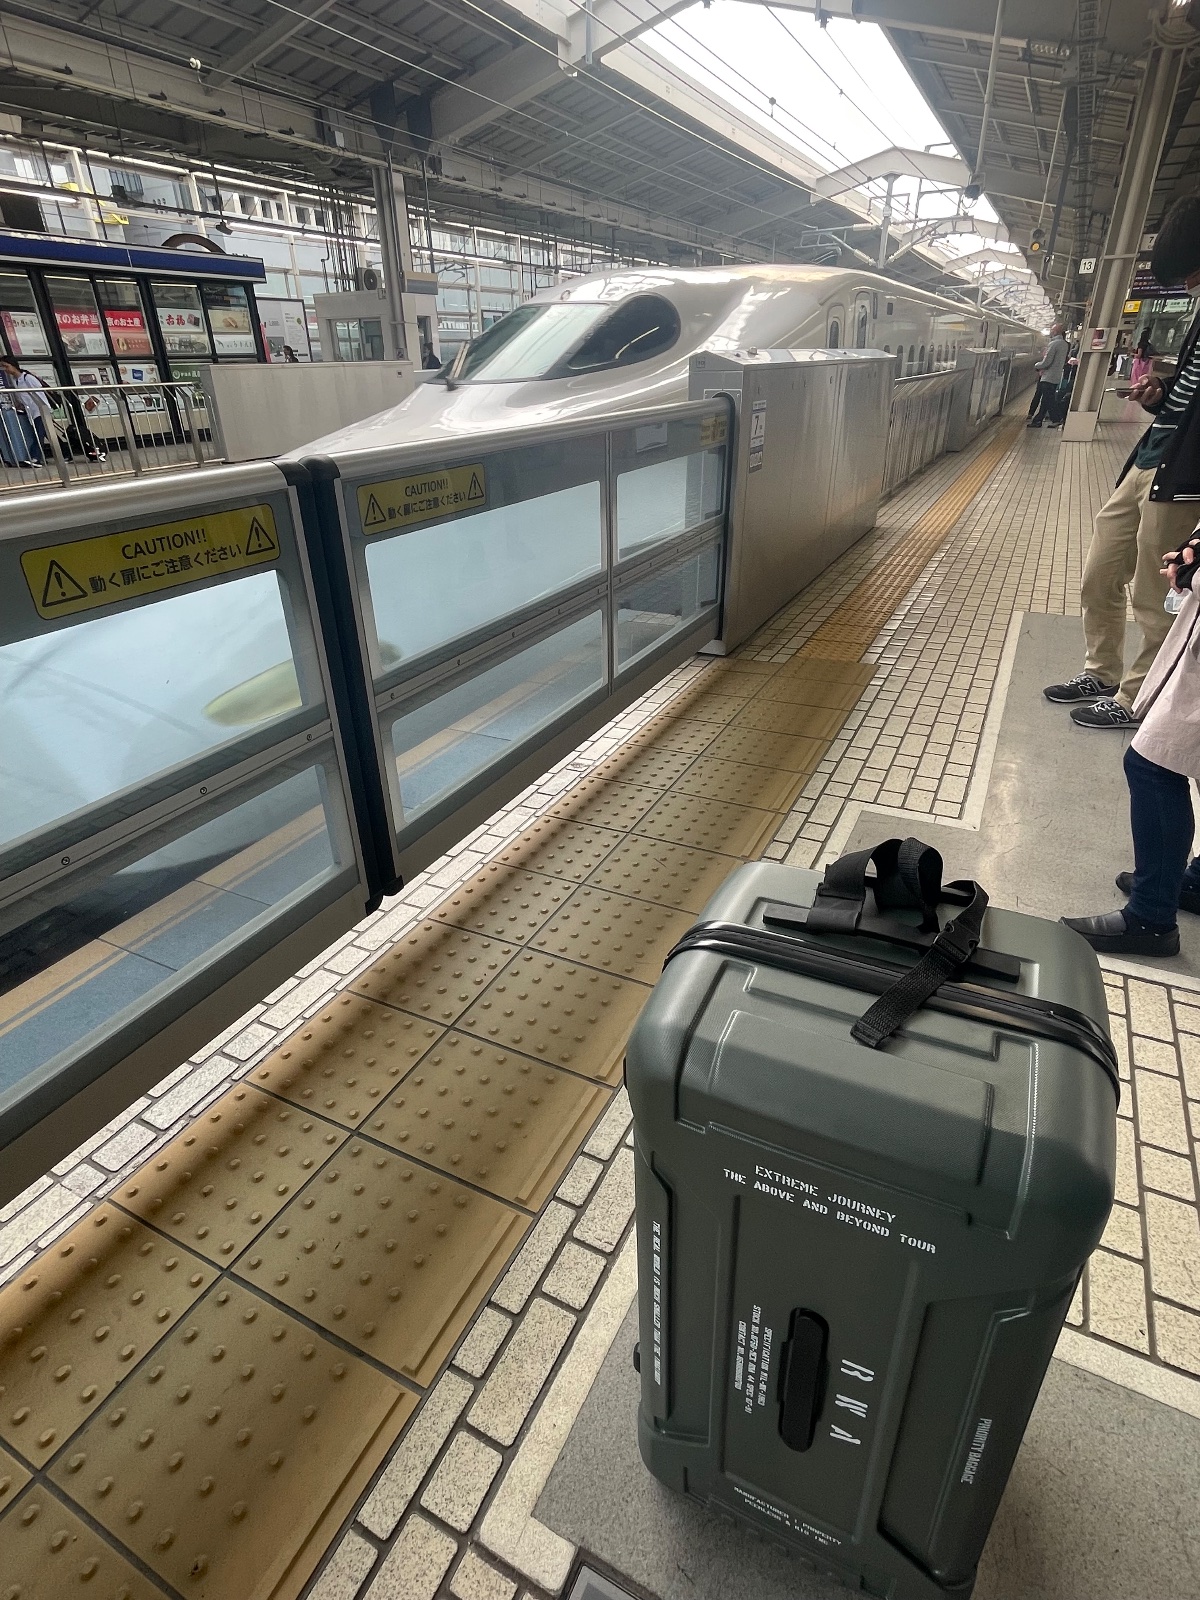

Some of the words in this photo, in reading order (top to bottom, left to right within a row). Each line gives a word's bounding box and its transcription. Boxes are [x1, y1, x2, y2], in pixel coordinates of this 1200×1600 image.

[1083, 261, 1093, 271] 13
[404, 478, 449, 498] CAUTION!!
[121, 528, 208, 560] CAUTION!!
[89, 544, 242, 594] 動く扉にご注意ください
[754, 1164, 819, 1197] EXTREME
[827, 1193, 896, 1223] JOURNEY
[723, 1168, 747, 1185] THE
[753, 1180, 795, 1203] ABOVE
[802, 1199, 828, 1215] AND
[836, 1210, 890, 1237] BEYOND
[899, 1233, 936, 1254] TOUR
[970, 1417, 993, 1452] PRIORITY
[960, 1451, 982, 1485] BAGGAGE
